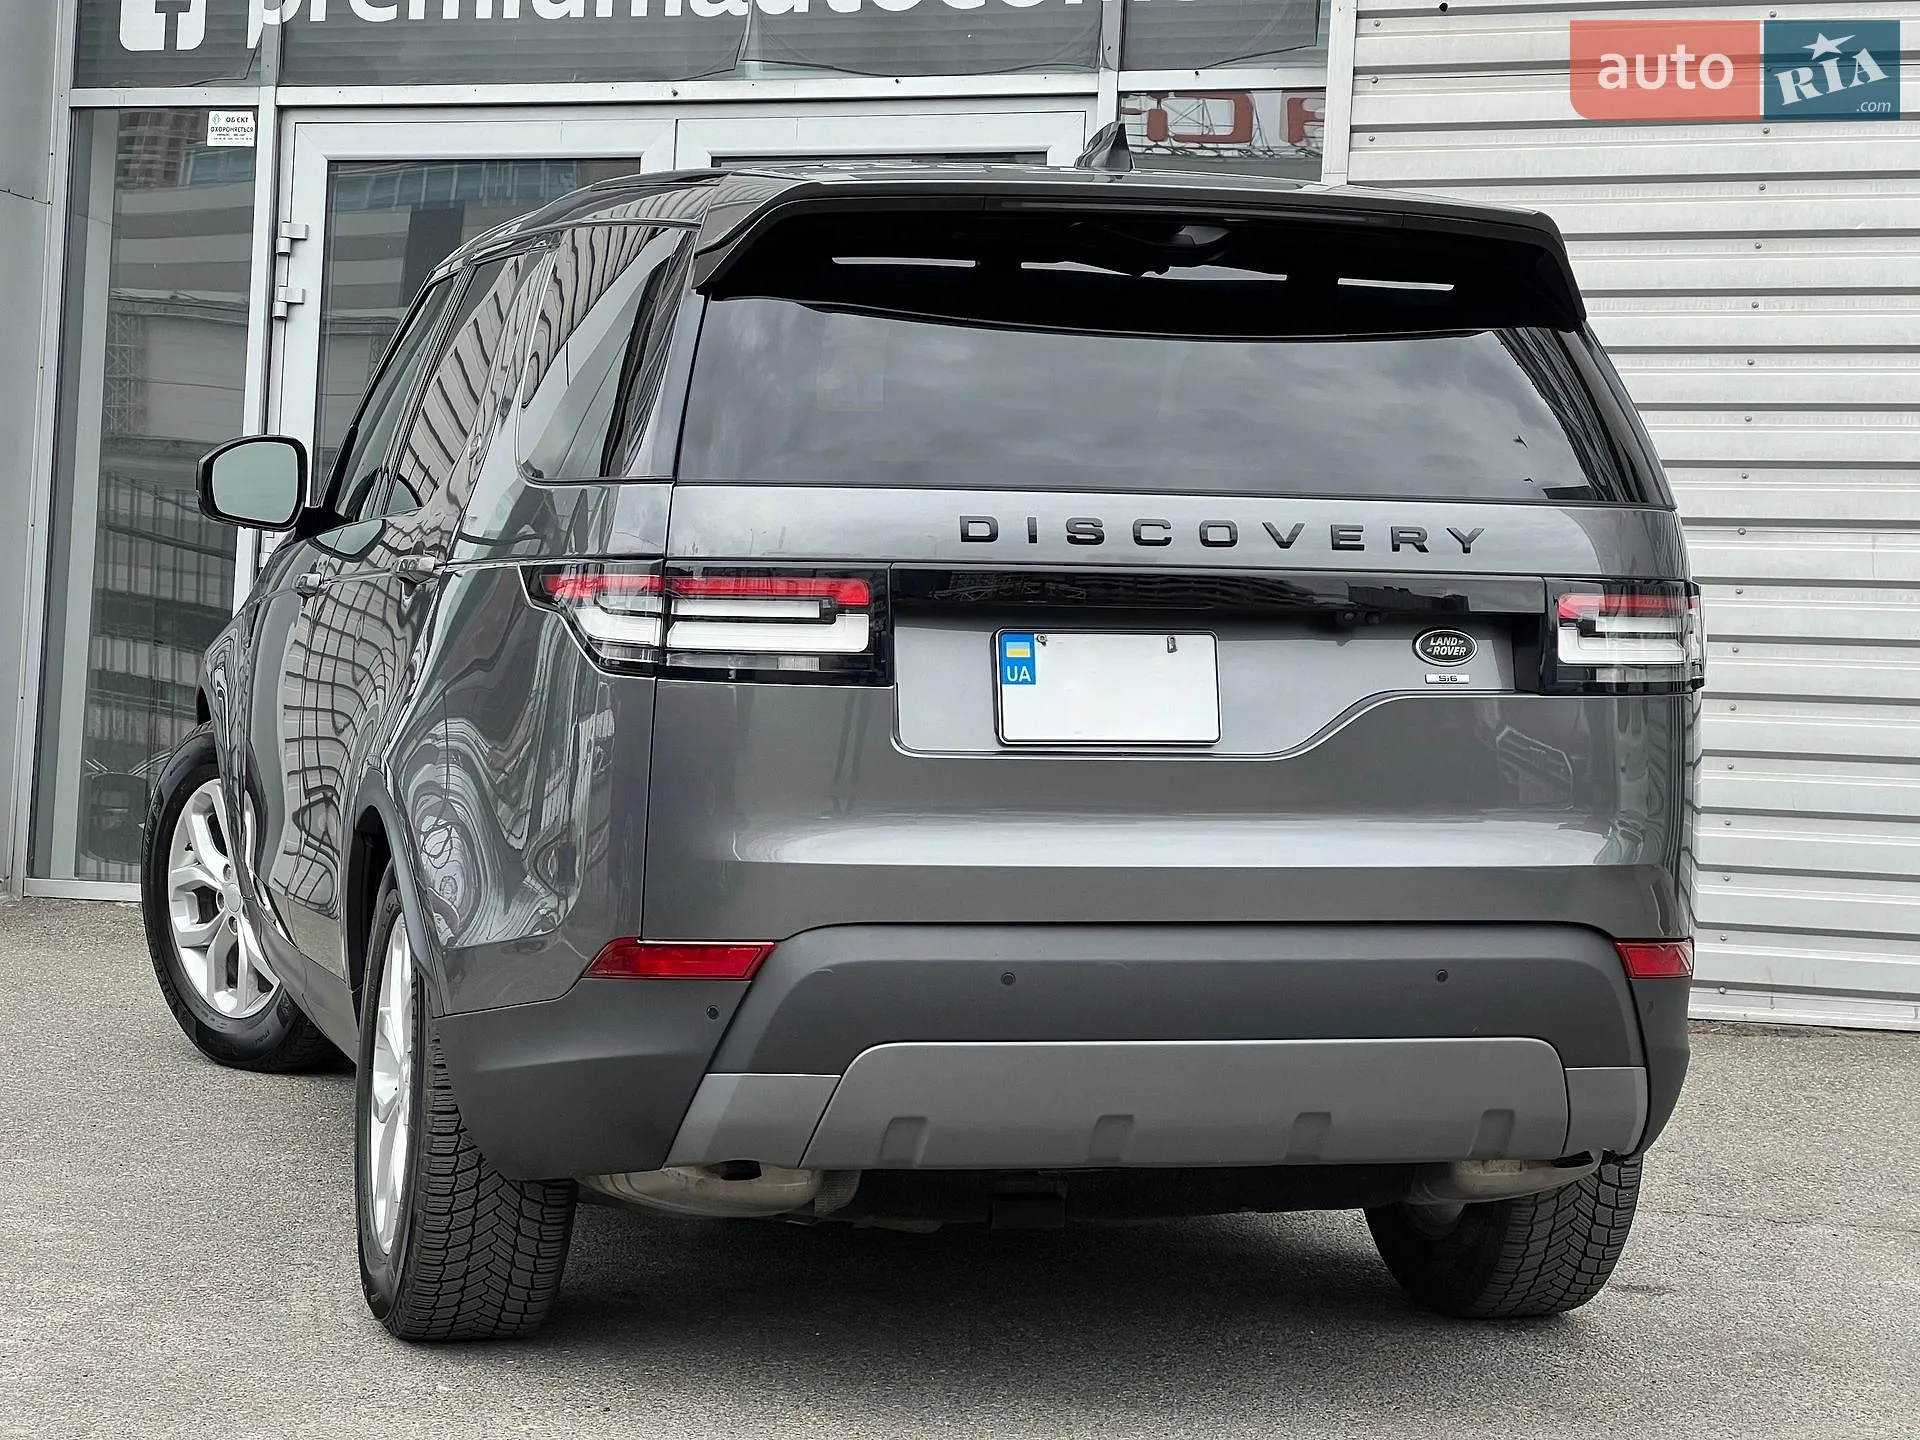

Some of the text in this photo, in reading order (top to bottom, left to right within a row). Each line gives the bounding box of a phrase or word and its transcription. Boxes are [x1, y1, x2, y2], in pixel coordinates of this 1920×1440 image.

[959, 515, 1485, 554] DISCOVERY
[1429, 636, 1458, 646] LAND
[1432, 646, 1467, 656] ROVER
[1006, 665, 1032, 682] UA
